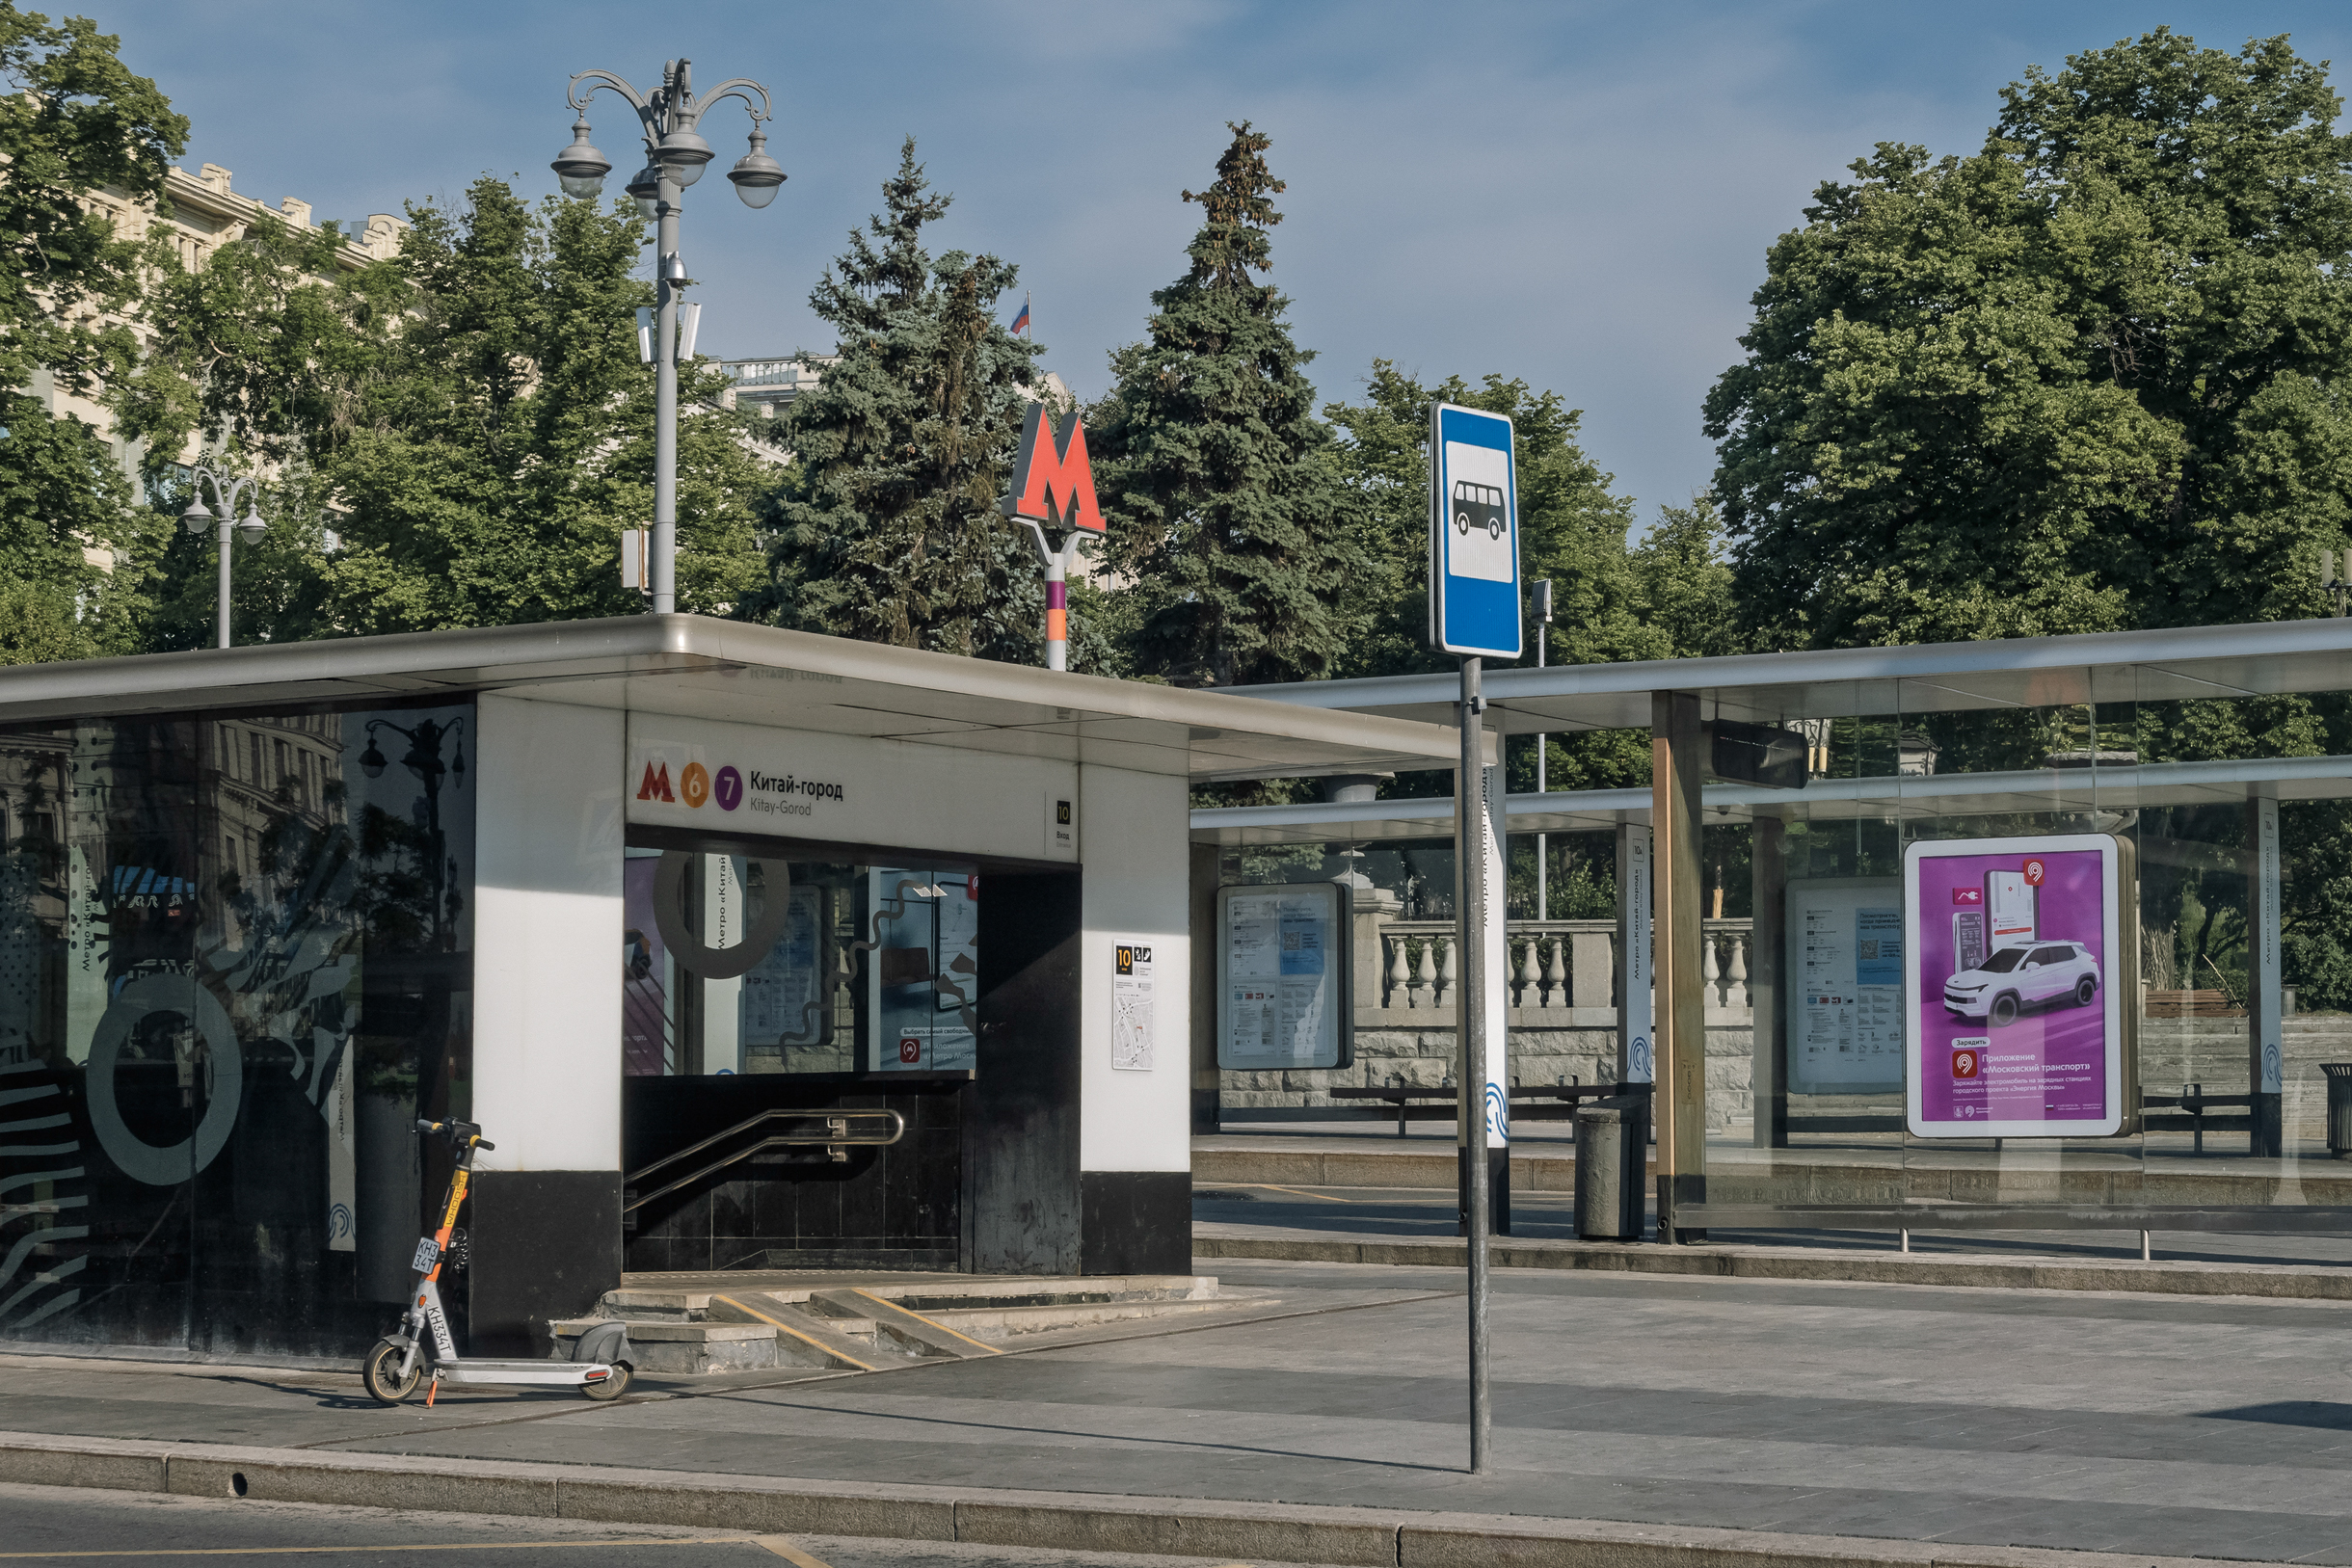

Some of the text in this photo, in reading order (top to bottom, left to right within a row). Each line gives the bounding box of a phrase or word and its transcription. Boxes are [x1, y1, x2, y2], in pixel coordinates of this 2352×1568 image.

[688, 773, 702, 798] 6
[723, 776, 735, 801] 7
[750, 770, 843, 802] Китай-город
[750, 797, 812, 816] Kitay-Gorod
[1058, 806, 1069, 821] 10
[718, 907, 727, 949] Метро
[82, 930, 91, 971] Метро
[1118, 949, 1131, 967] 10
[1982, 1054, 2036, 1064] Приложение
[1982, 1063, 2091, 1074] «Московский транспорт»
[446, 1174, 467, 1226] WHOOSH
